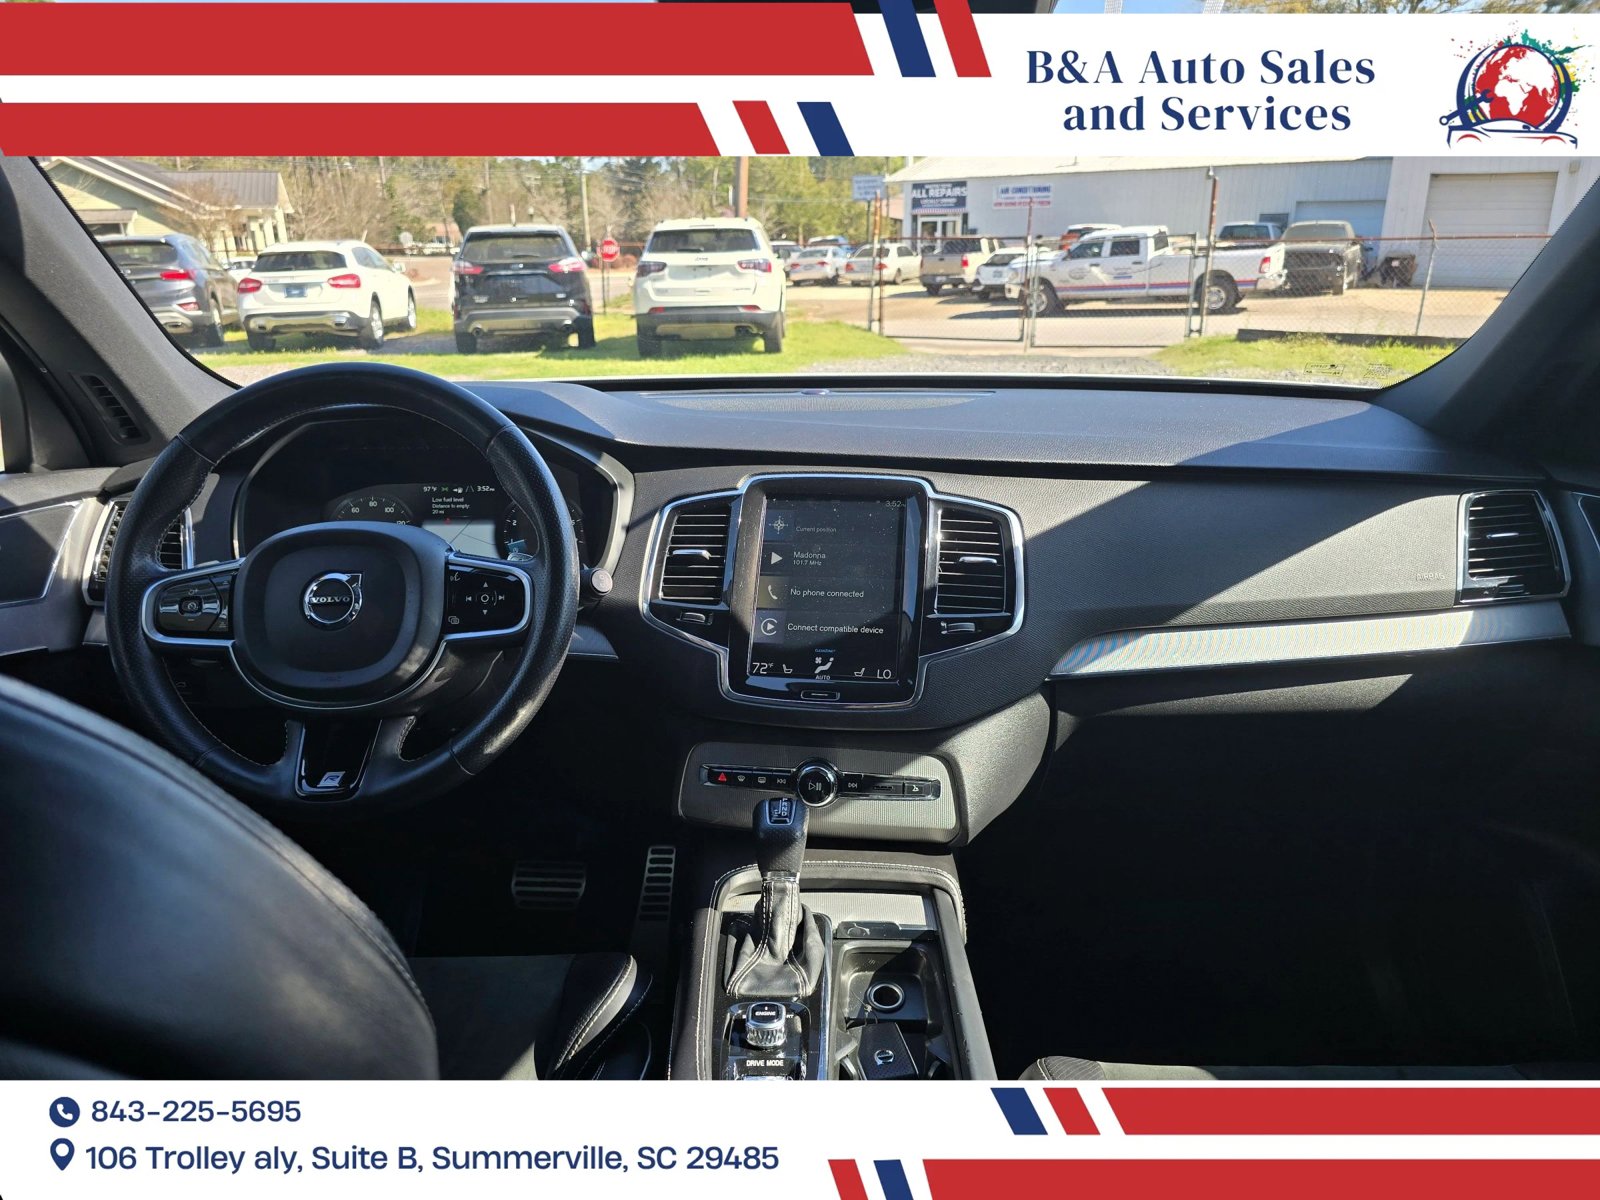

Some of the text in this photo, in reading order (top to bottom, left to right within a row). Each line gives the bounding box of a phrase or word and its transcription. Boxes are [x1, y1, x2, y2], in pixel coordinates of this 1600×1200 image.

[912, 187, 967, 198] ALL REPAIRS
[793, 551, 826, 559] Madonna
[790, 588, 865, 598] No phone connected
[787, 623, 884, 634] Connect compatible device
[877, 669, 892, 680] LO
